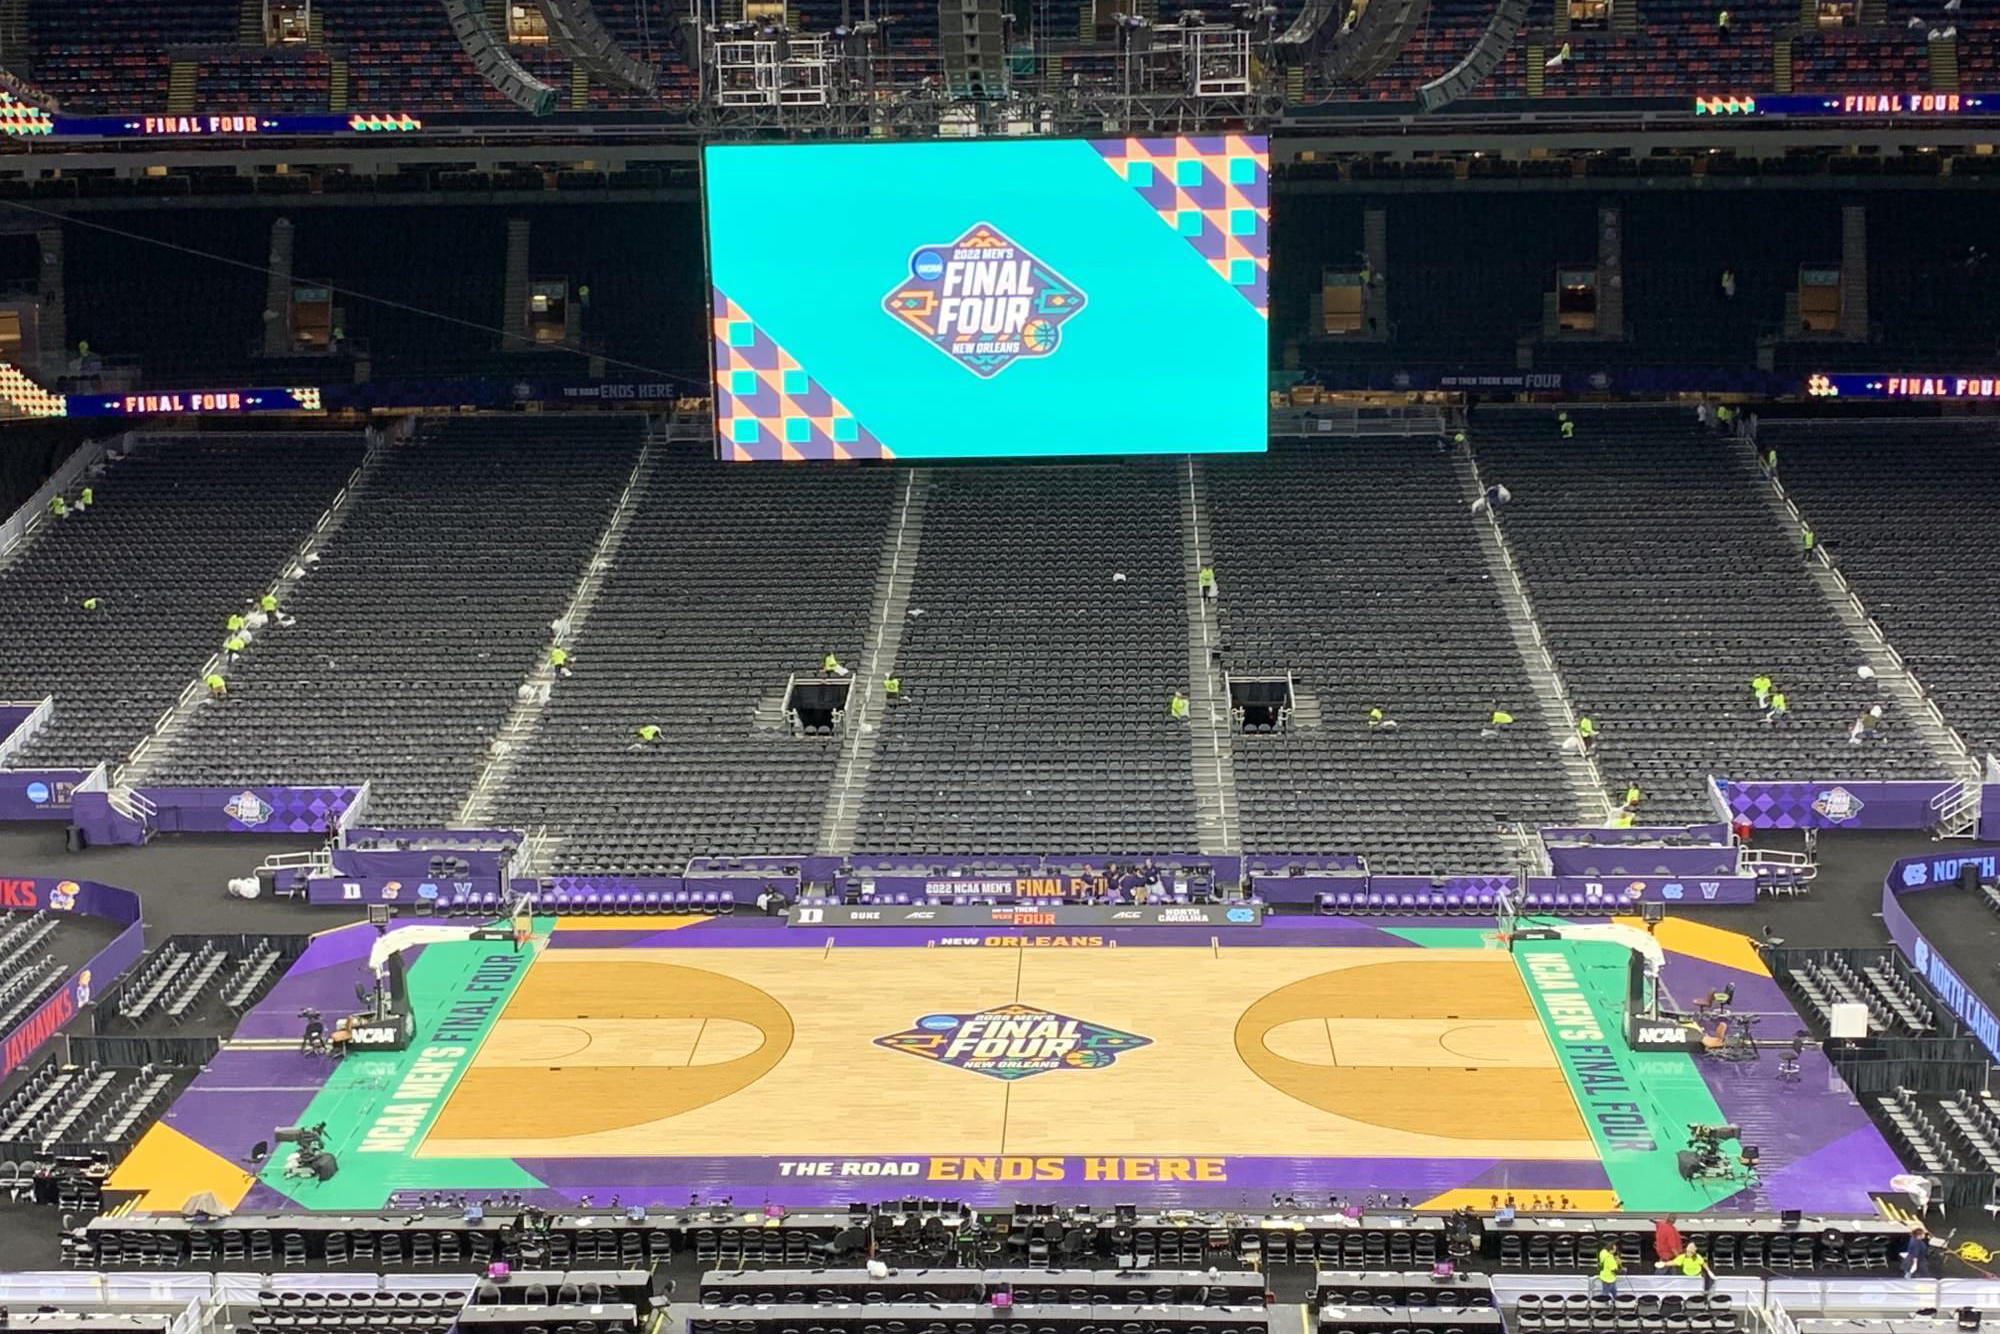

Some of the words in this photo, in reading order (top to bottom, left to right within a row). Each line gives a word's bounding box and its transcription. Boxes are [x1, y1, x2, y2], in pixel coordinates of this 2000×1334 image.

[1845, 96, 1902, 112] FINAL
[1911, 95, 1960, 111] FOUR
[145, 117, 202, 133] FINAL
[210, 116, 258, 132] FOUR
[982, 248, 1014, 259] MEN'S
[943, 260, 1034, 296] FINAL
[938, 296, 1031, 334] FOUR
[952, 343, 975, 354] NEW
[976, 342, 1020, 353] ORLEANS
[1525, 374, 1562, 388] FOUR
[1888, 378, 1947, 395] FINAL
[600, 384, 634, 398] ENDS
[639, 384, 674, 398] HERE
[126, 396, 184, 412] FINAL
[192, 394, 241, 410] FOUR
[1933, 856, 1996, 882] NOH
[0, 879, 37, 907] KS
[926, 883, 952, 894] 2022
[954, 883, 980, 894] NCAA
[982, 883, 1012, 894] MEN'S
[1015, 879, 1067, 897] FINAL
[1014, 912, 1056, 925] FOUR
[1112, 911, 1143, 919] ACC
[1158, 914, 1209, 922] CAROLINA
[941, 937, 979, 945] NEW
[984, 936, 1103, 947] ORLEANS
[464, 954, 525, 992] FOUR
[1523, 952, 1580, 991] NCAA
[1929, 953, 1965, 1019] NORTH
[431, 996, 499, 1042] FINAL
[1541, 992, 1605, 1041] MEN'S
[4, 987, 73, 1076] JAYHAWKS
[350, 1027, 398, 1043] NCAA
[956, 1020, 1082, 1038] FINAL
[1637, 1027, 1688, 1043] NCAA
[944, 1037, 1079, 1058] FOUR
[392, 1046, 468, 1099] MEN'S
[1565, 1045, 1630, 1096] FINAL
[356, 1102, 433, 1152] NCAA
[1590, 1101, 1658, 1151] FOUR
[779, 1162, 833, 1176] THE
[841, 1162, 921, 1176] ROAD
[926, 1157, 1066, 1181] ENDS
[1084, 1158, 1228, 1182] HERE
